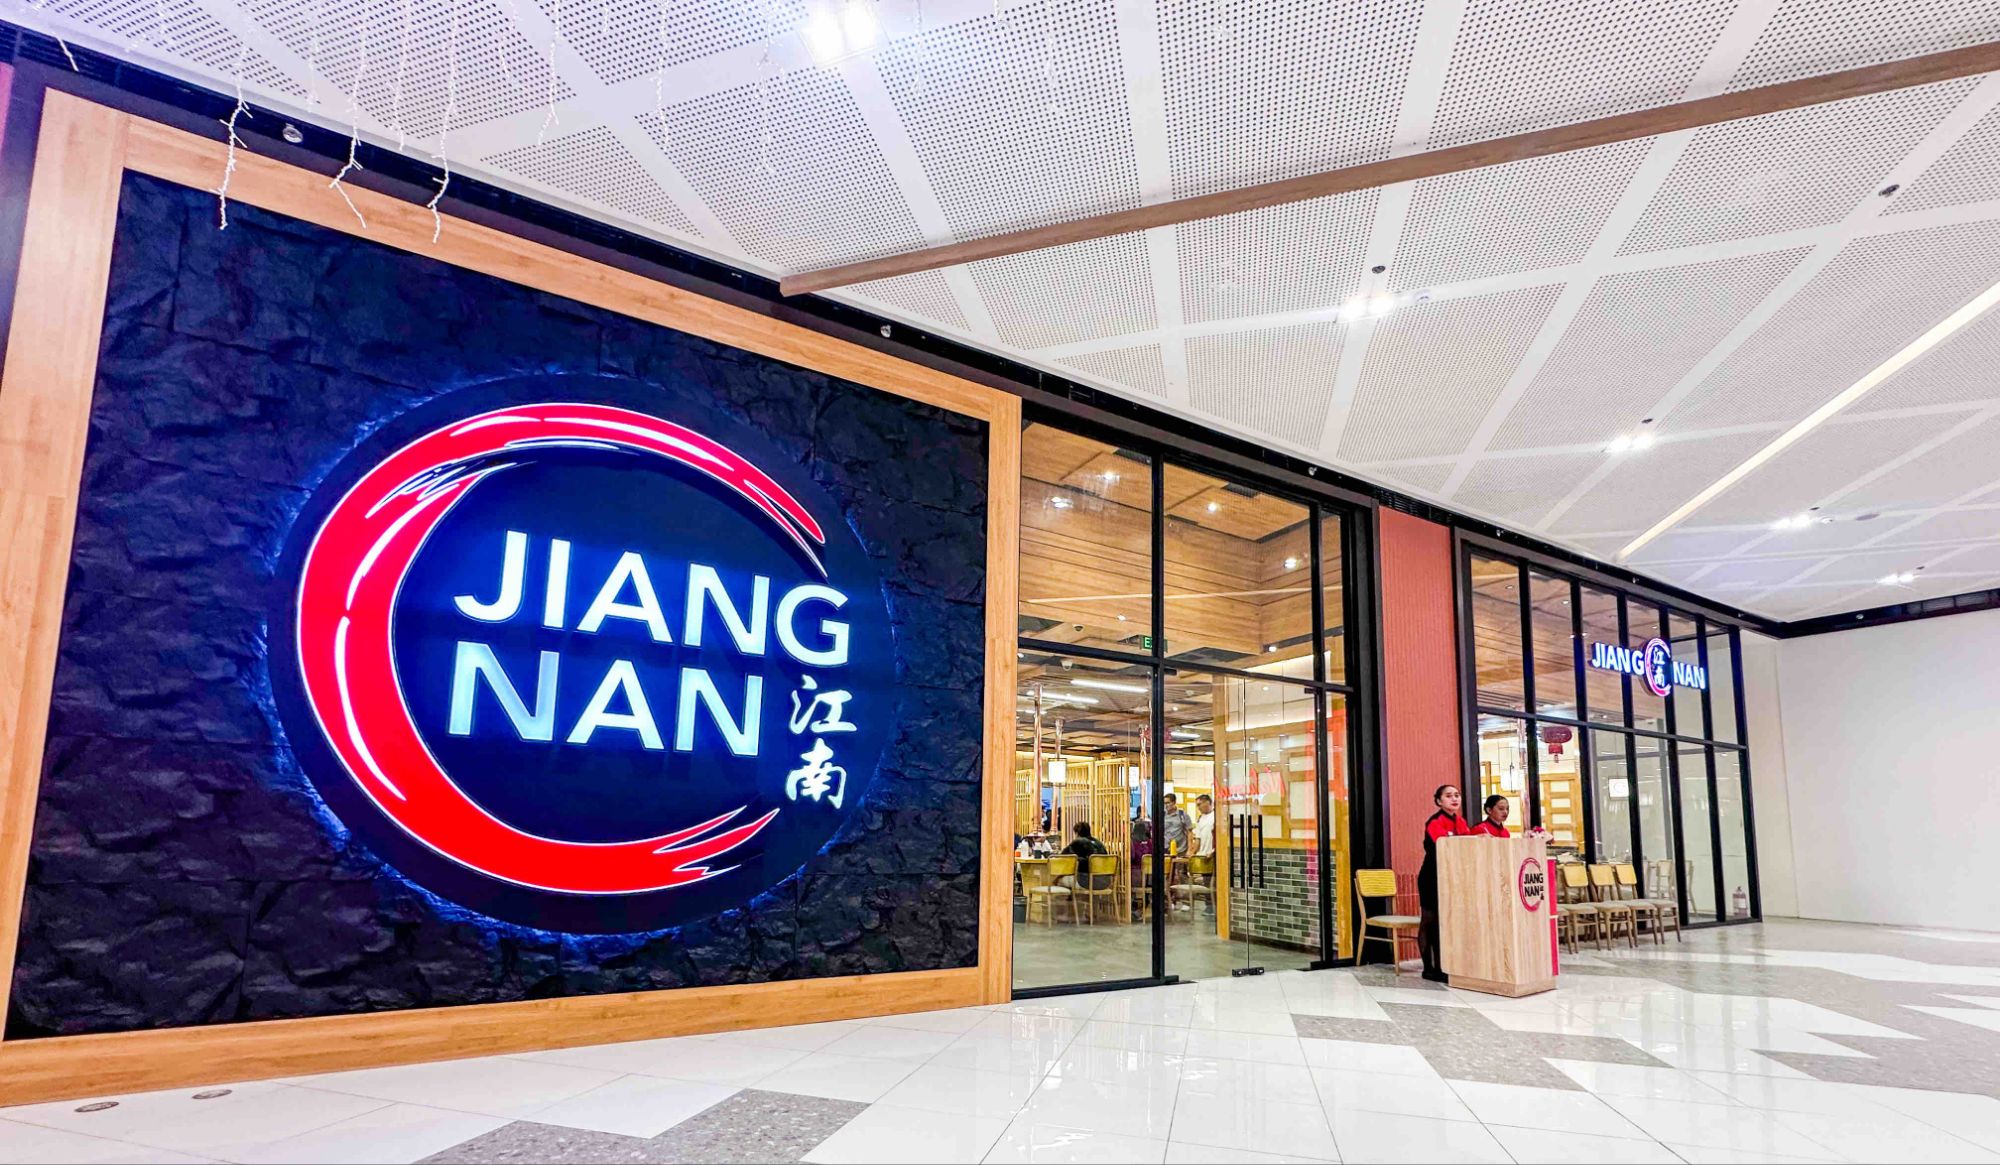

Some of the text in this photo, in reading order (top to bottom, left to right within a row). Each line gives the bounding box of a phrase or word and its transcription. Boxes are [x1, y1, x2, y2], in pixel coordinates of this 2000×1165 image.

[453, 529, 850, 667] JIANG
[447, 639, 764, 757] NAN
[1591, 642, 1706, 690] JIANG NAN
[785, 673, 858, 810] 江南
[1523, 872, 1544, 885] JIANG
[1524, 885, 1540, 898] NAN
